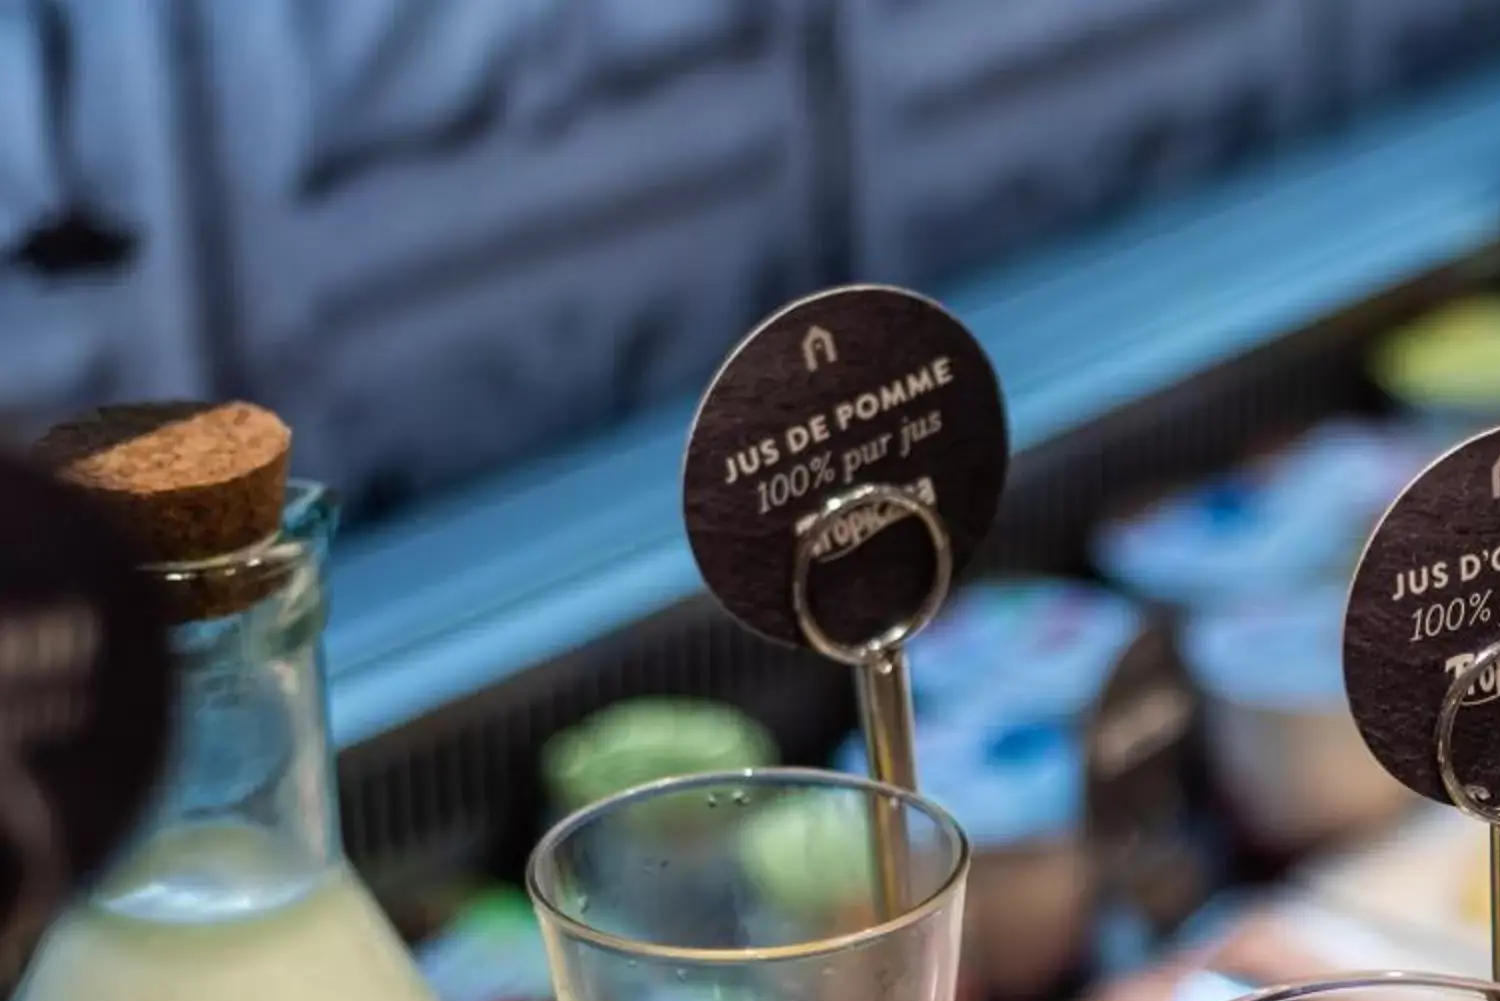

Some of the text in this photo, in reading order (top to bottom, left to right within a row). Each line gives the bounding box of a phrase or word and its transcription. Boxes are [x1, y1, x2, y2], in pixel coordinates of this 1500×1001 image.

[724, 356, 955, 485] JUS DE POMME
[756, 408, 943, 515] 100% pur jus
[1391, 561, 1449, 601] JUS
[1409, 591, 1491, 643] 100%
